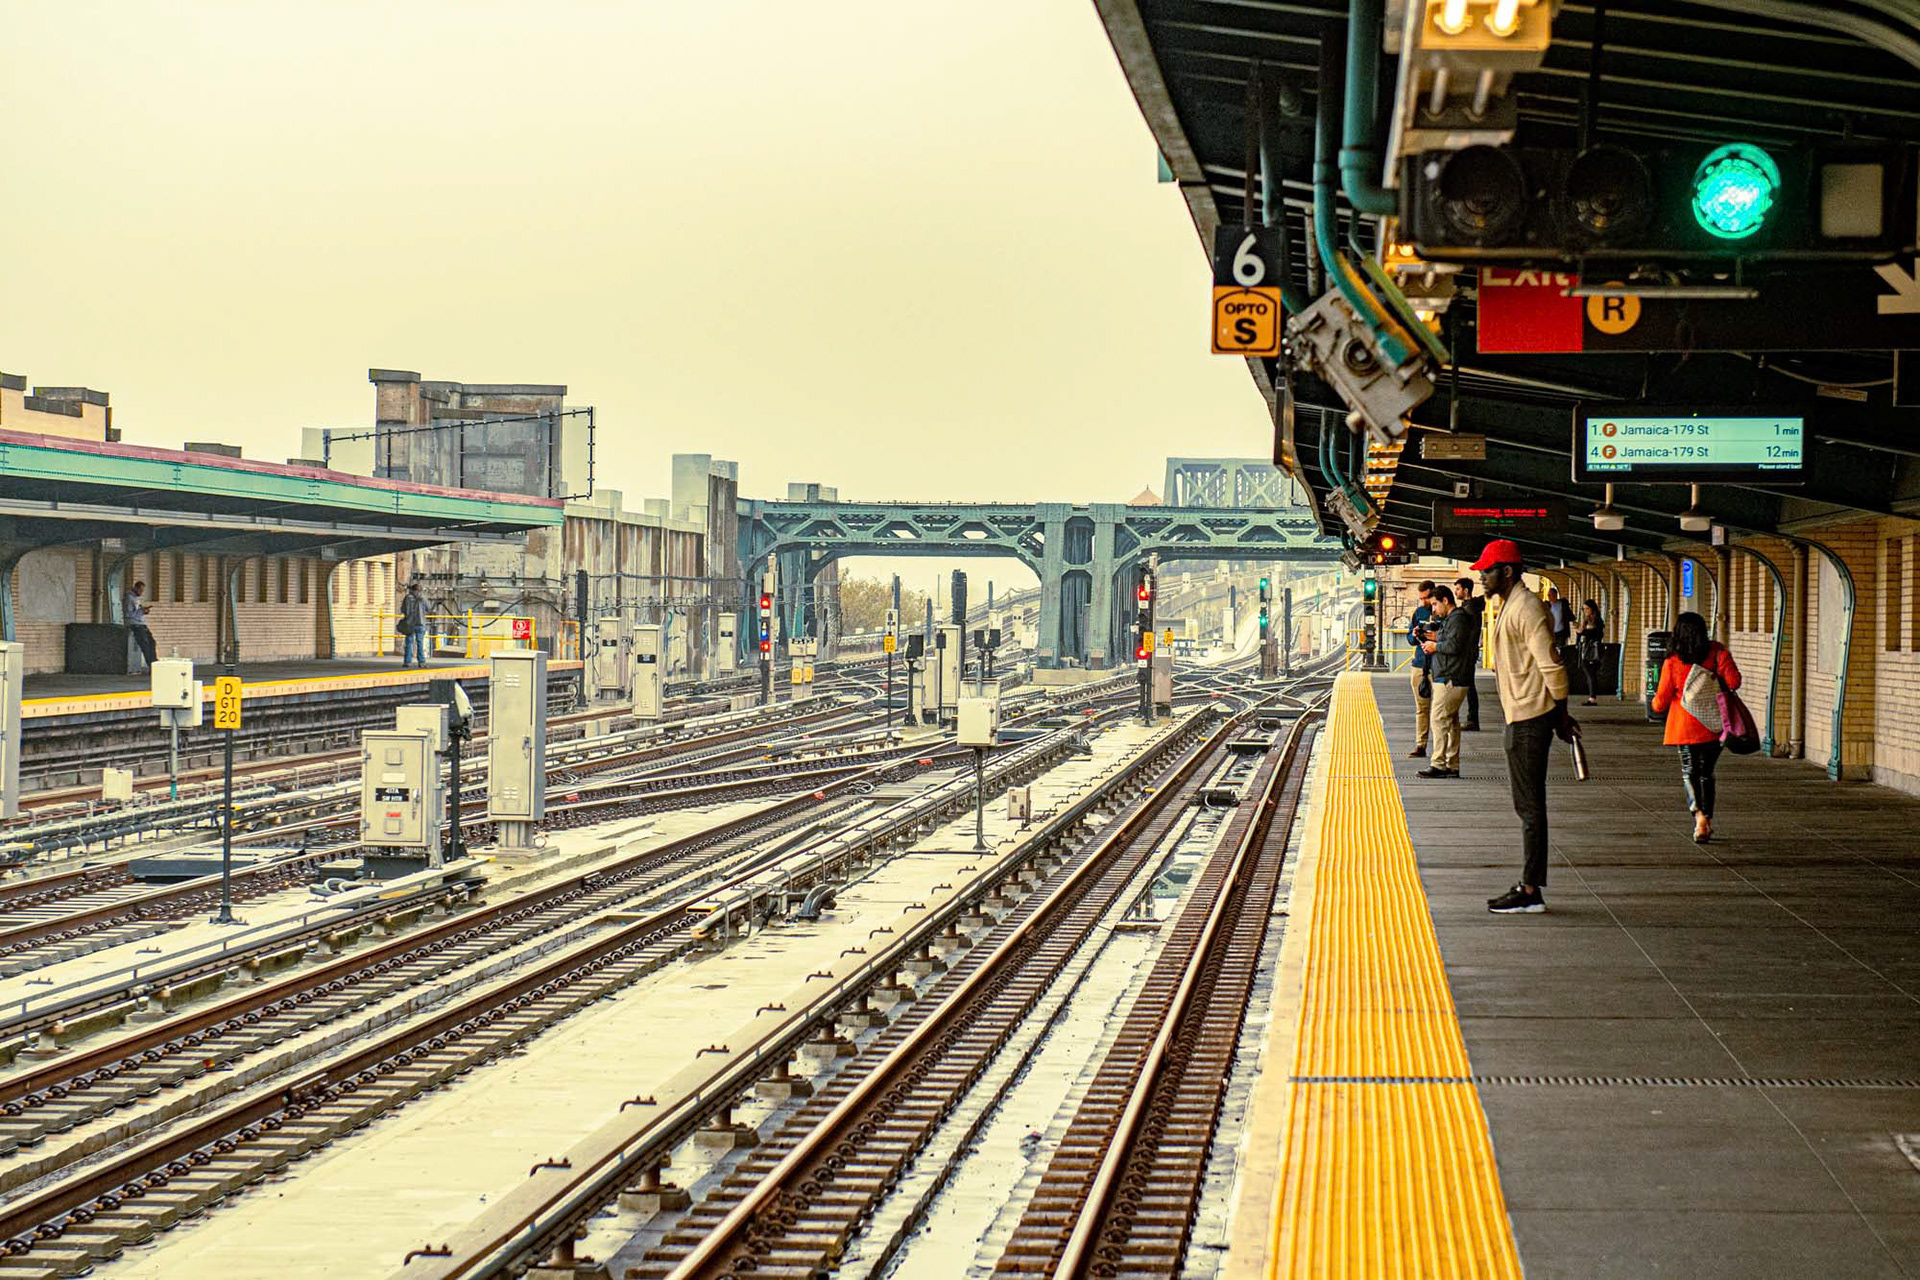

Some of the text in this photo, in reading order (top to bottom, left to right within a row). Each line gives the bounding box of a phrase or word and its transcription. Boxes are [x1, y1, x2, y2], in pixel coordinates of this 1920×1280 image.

[1232, 233, 1266, 287] 6
[1224, 302, 1268, 315] OPTO
[1602, 295, 1626, 321] R
[1234, 317, 1257, 345] S
[1620, 424, 1694, 436] Jamaica-179
[1697, 424, 1709, 436] St
[1773, 424, 1780, 436] 1
[1782, 426, 1799, 436] min
[1620, 446, 1694, 457] Jamaica-179
[1697, 446, 1709, 457] St
[1766, 446, 1781, 458] 12
[1782, 448, 1799, 458] min
[225, 683, 233, 695] D
[220, 697, 237, 708] GT
[219, 711, 237, 722] 20
